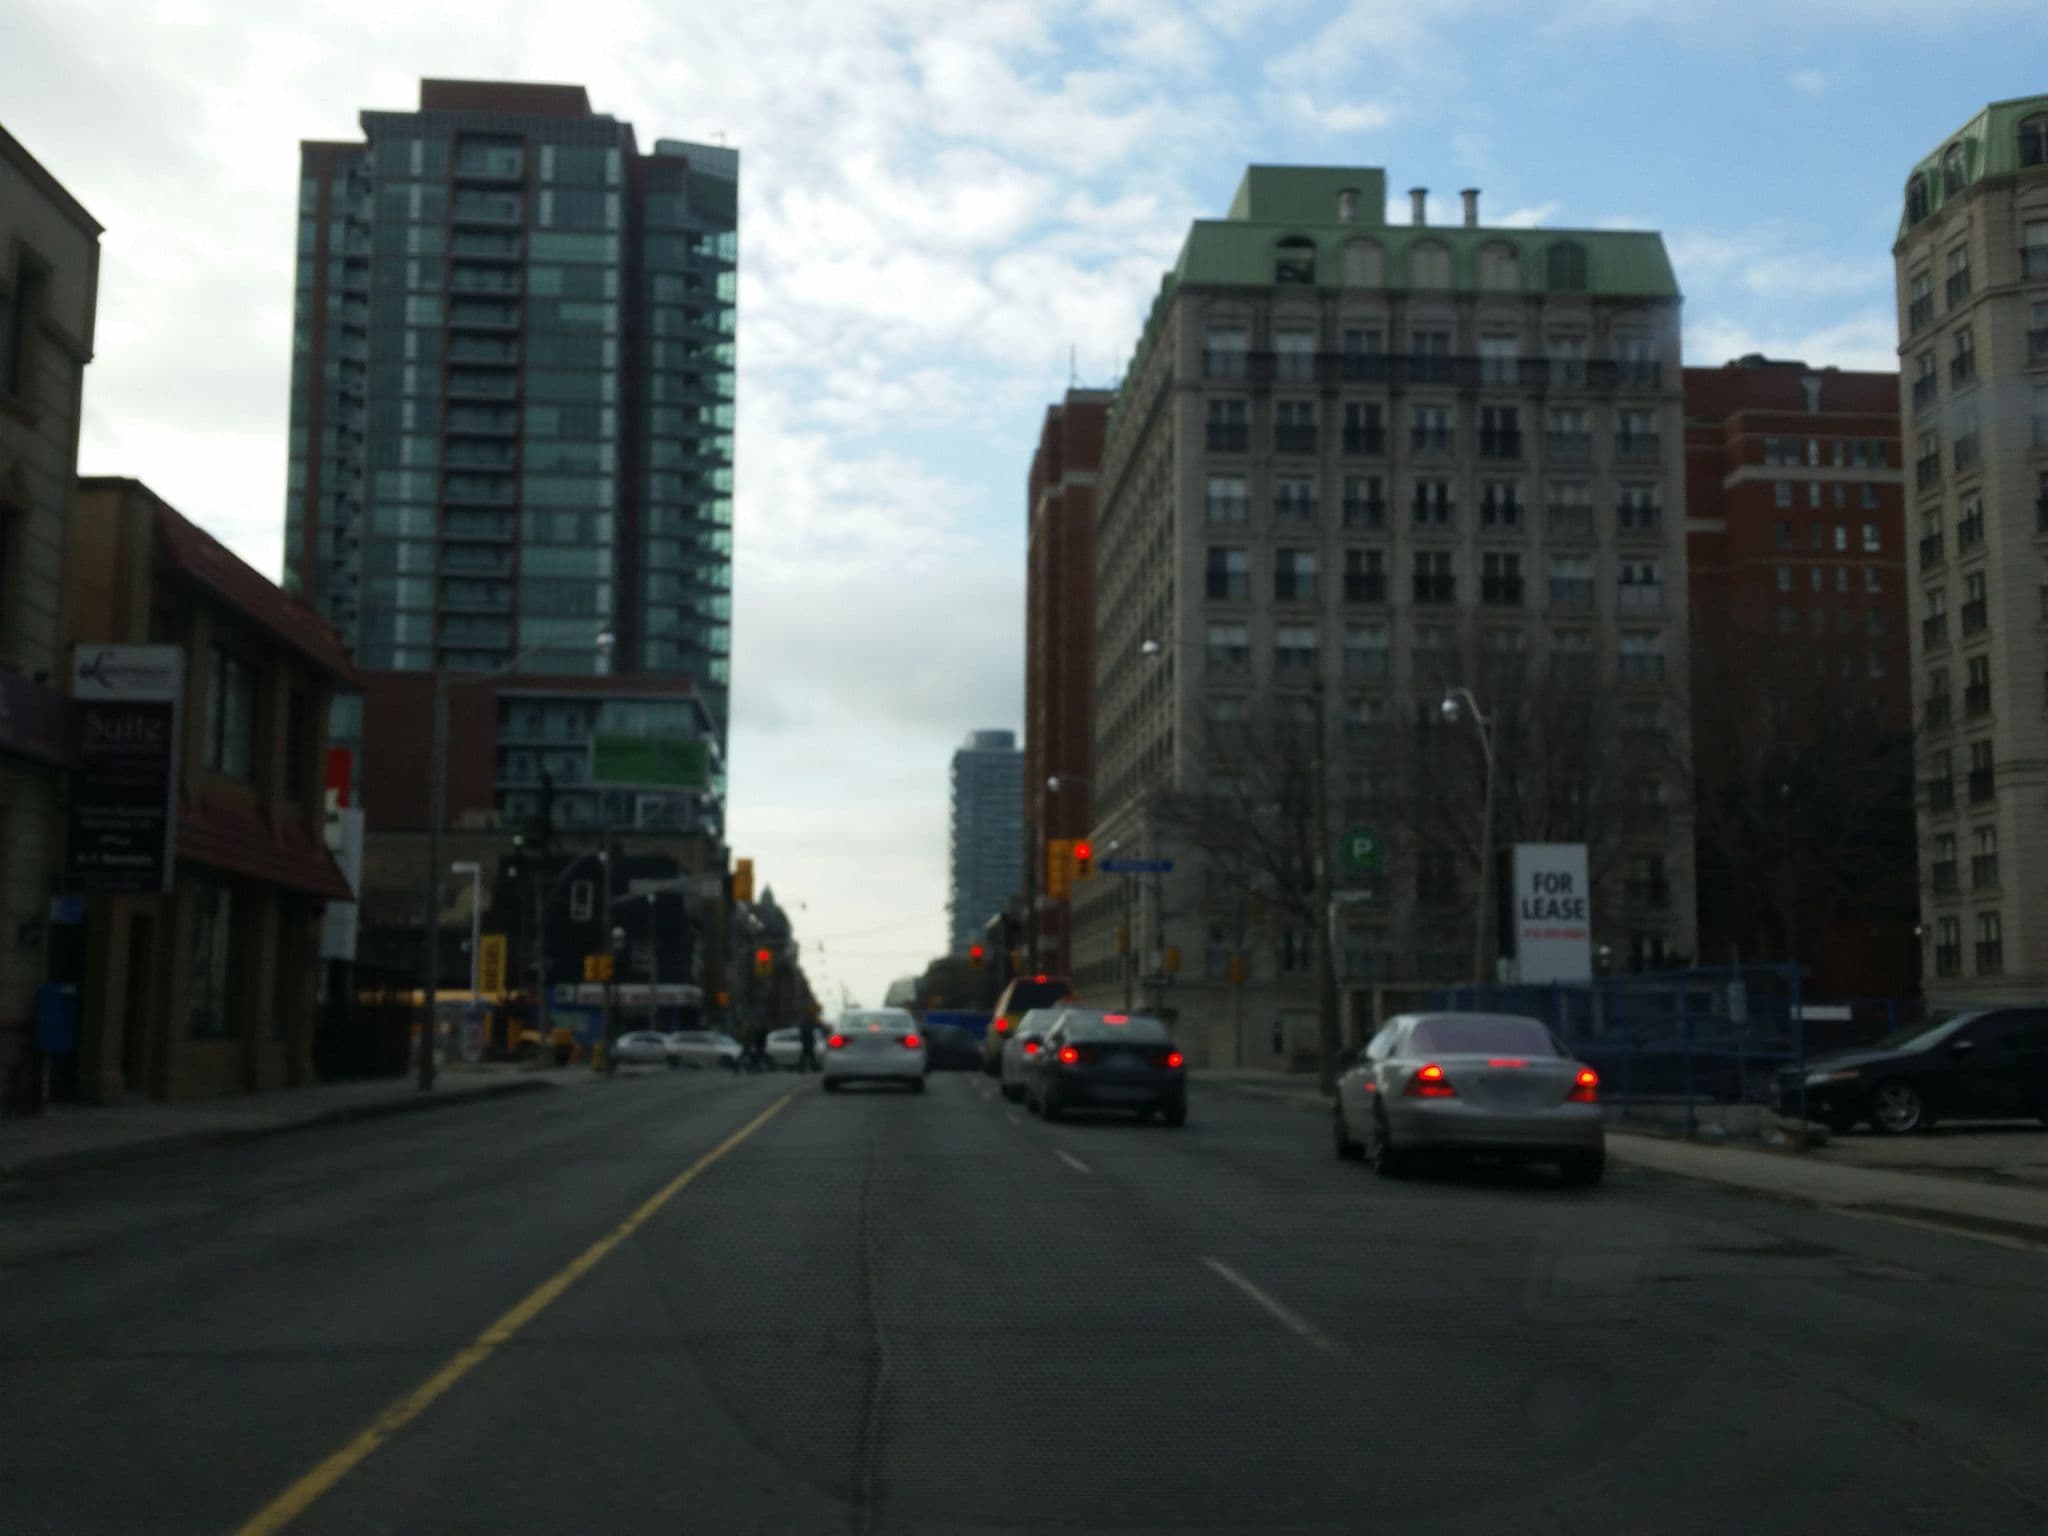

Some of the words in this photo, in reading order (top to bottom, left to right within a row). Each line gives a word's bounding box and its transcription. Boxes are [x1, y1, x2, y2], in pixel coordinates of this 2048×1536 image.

[1352, 837, 1372, 859] P
[1533, 871, 1574, 895] FOR
[1521, 898, 1585, 920] LEASE
